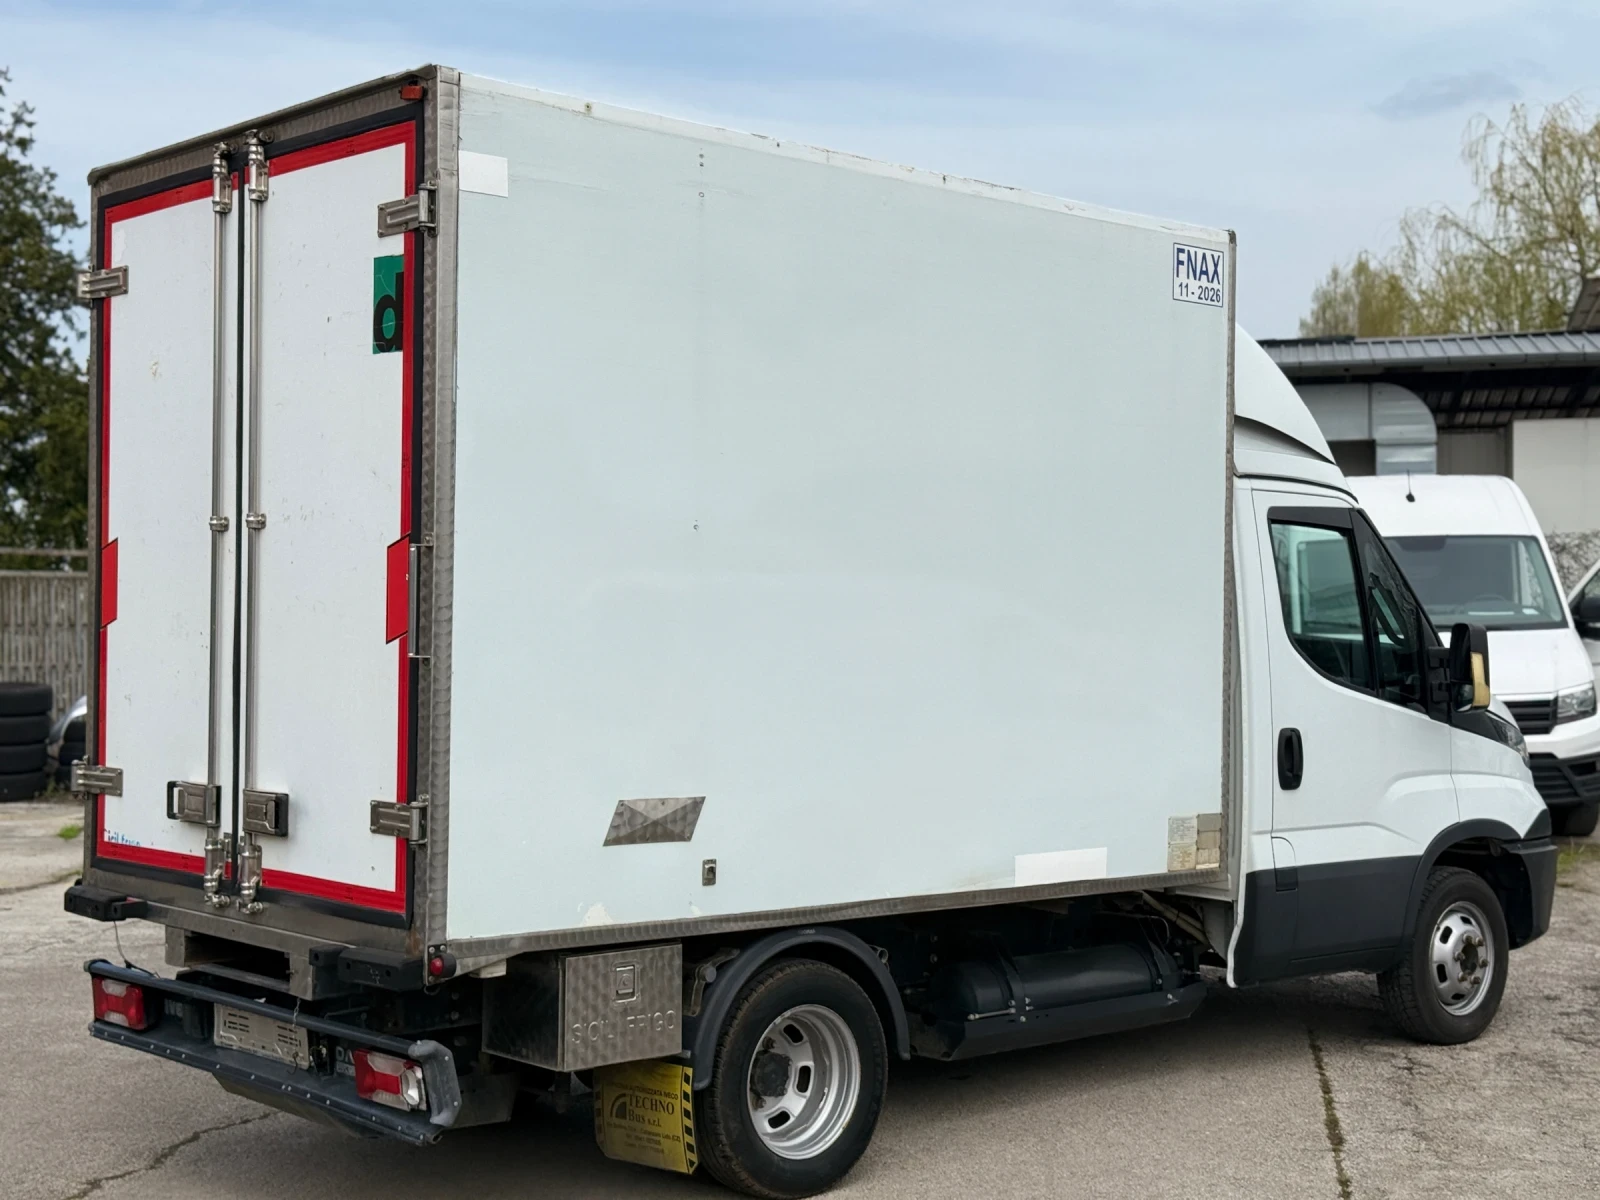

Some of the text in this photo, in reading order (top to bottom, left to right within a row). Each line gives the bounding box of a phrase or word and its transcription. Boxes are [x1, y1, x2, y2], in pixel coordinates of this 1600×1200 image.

[1176, 247, 1220, 285] FNAX
[1197, 285, 1221, 303] 2026
[628, 1093, 675, 1115] TECHNO
[628, 1108, 646, 1124] Bus
[647, 1117, 662, 1128] s.r.l.
